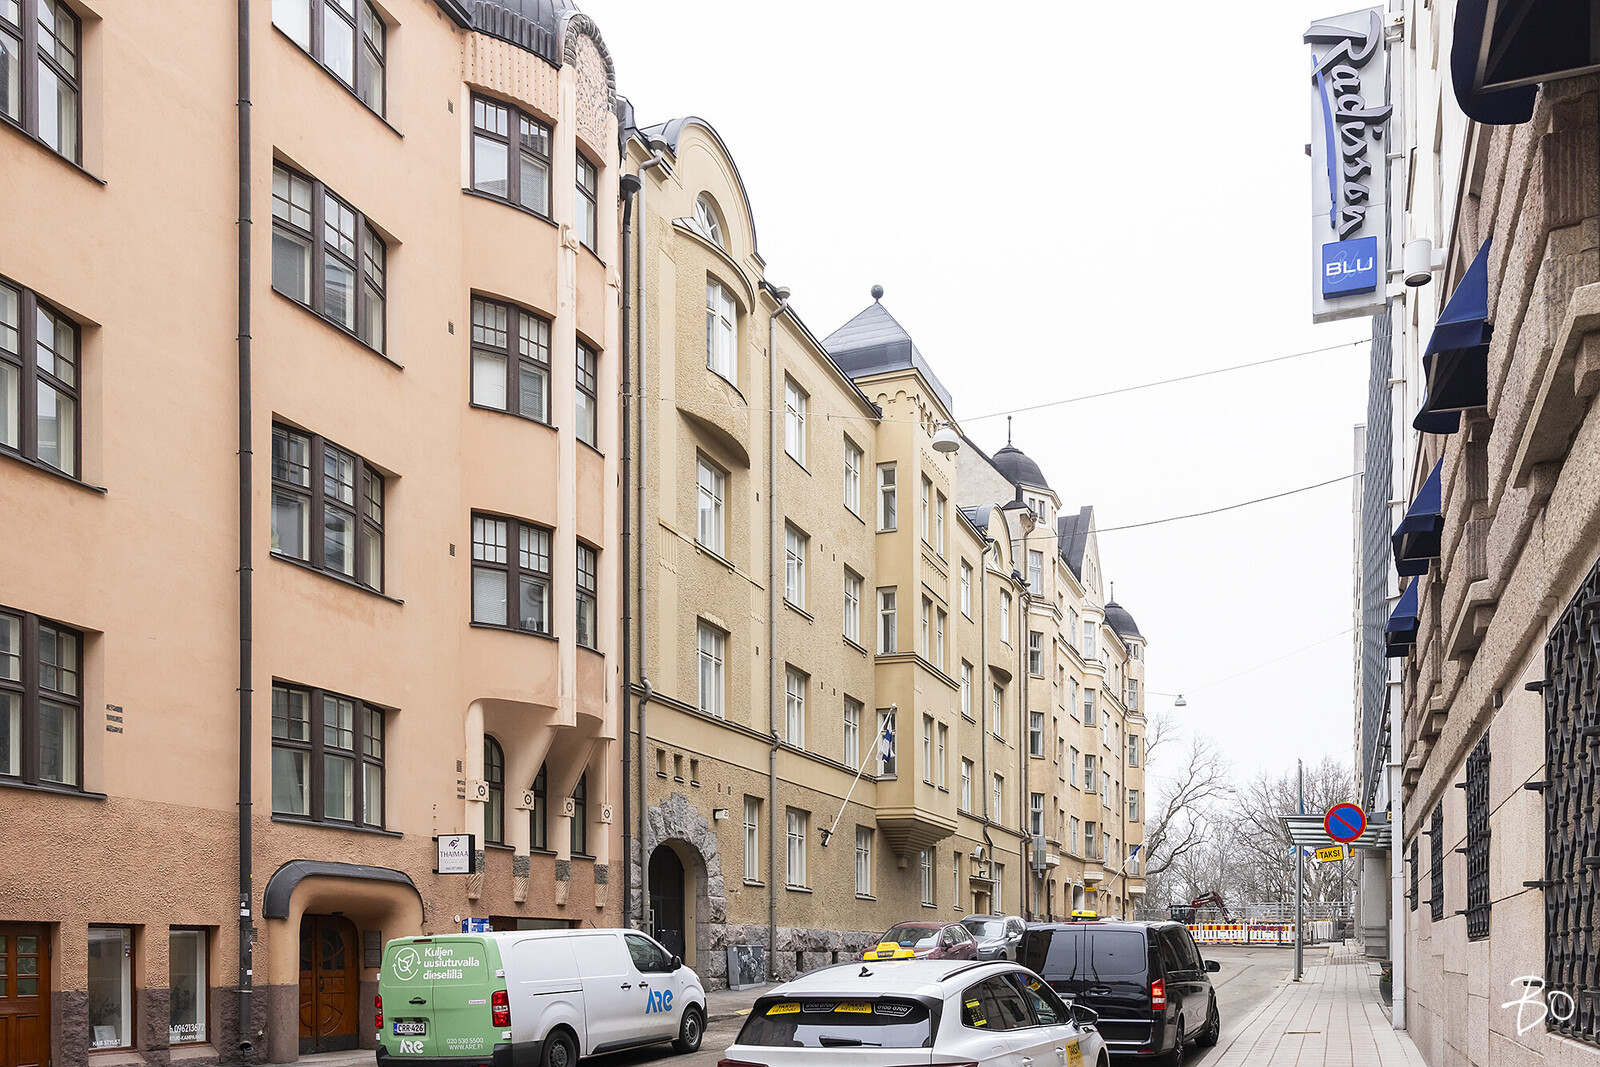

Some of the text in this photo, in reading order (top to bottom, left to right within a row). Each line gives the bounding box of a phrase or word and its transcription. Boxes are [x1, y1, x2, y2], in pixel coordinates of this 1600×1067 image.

[1303, 10, 1393, 241] Radisson
[1326, 257, 1373, 276] BLU
[1320, 850, 1340, 859] TAKSI
[424, 946, 453, 960] Kuljen
[423, 956, 480, 968] uusiutuvalla
[422, 969, 463, 980] dieselillä
